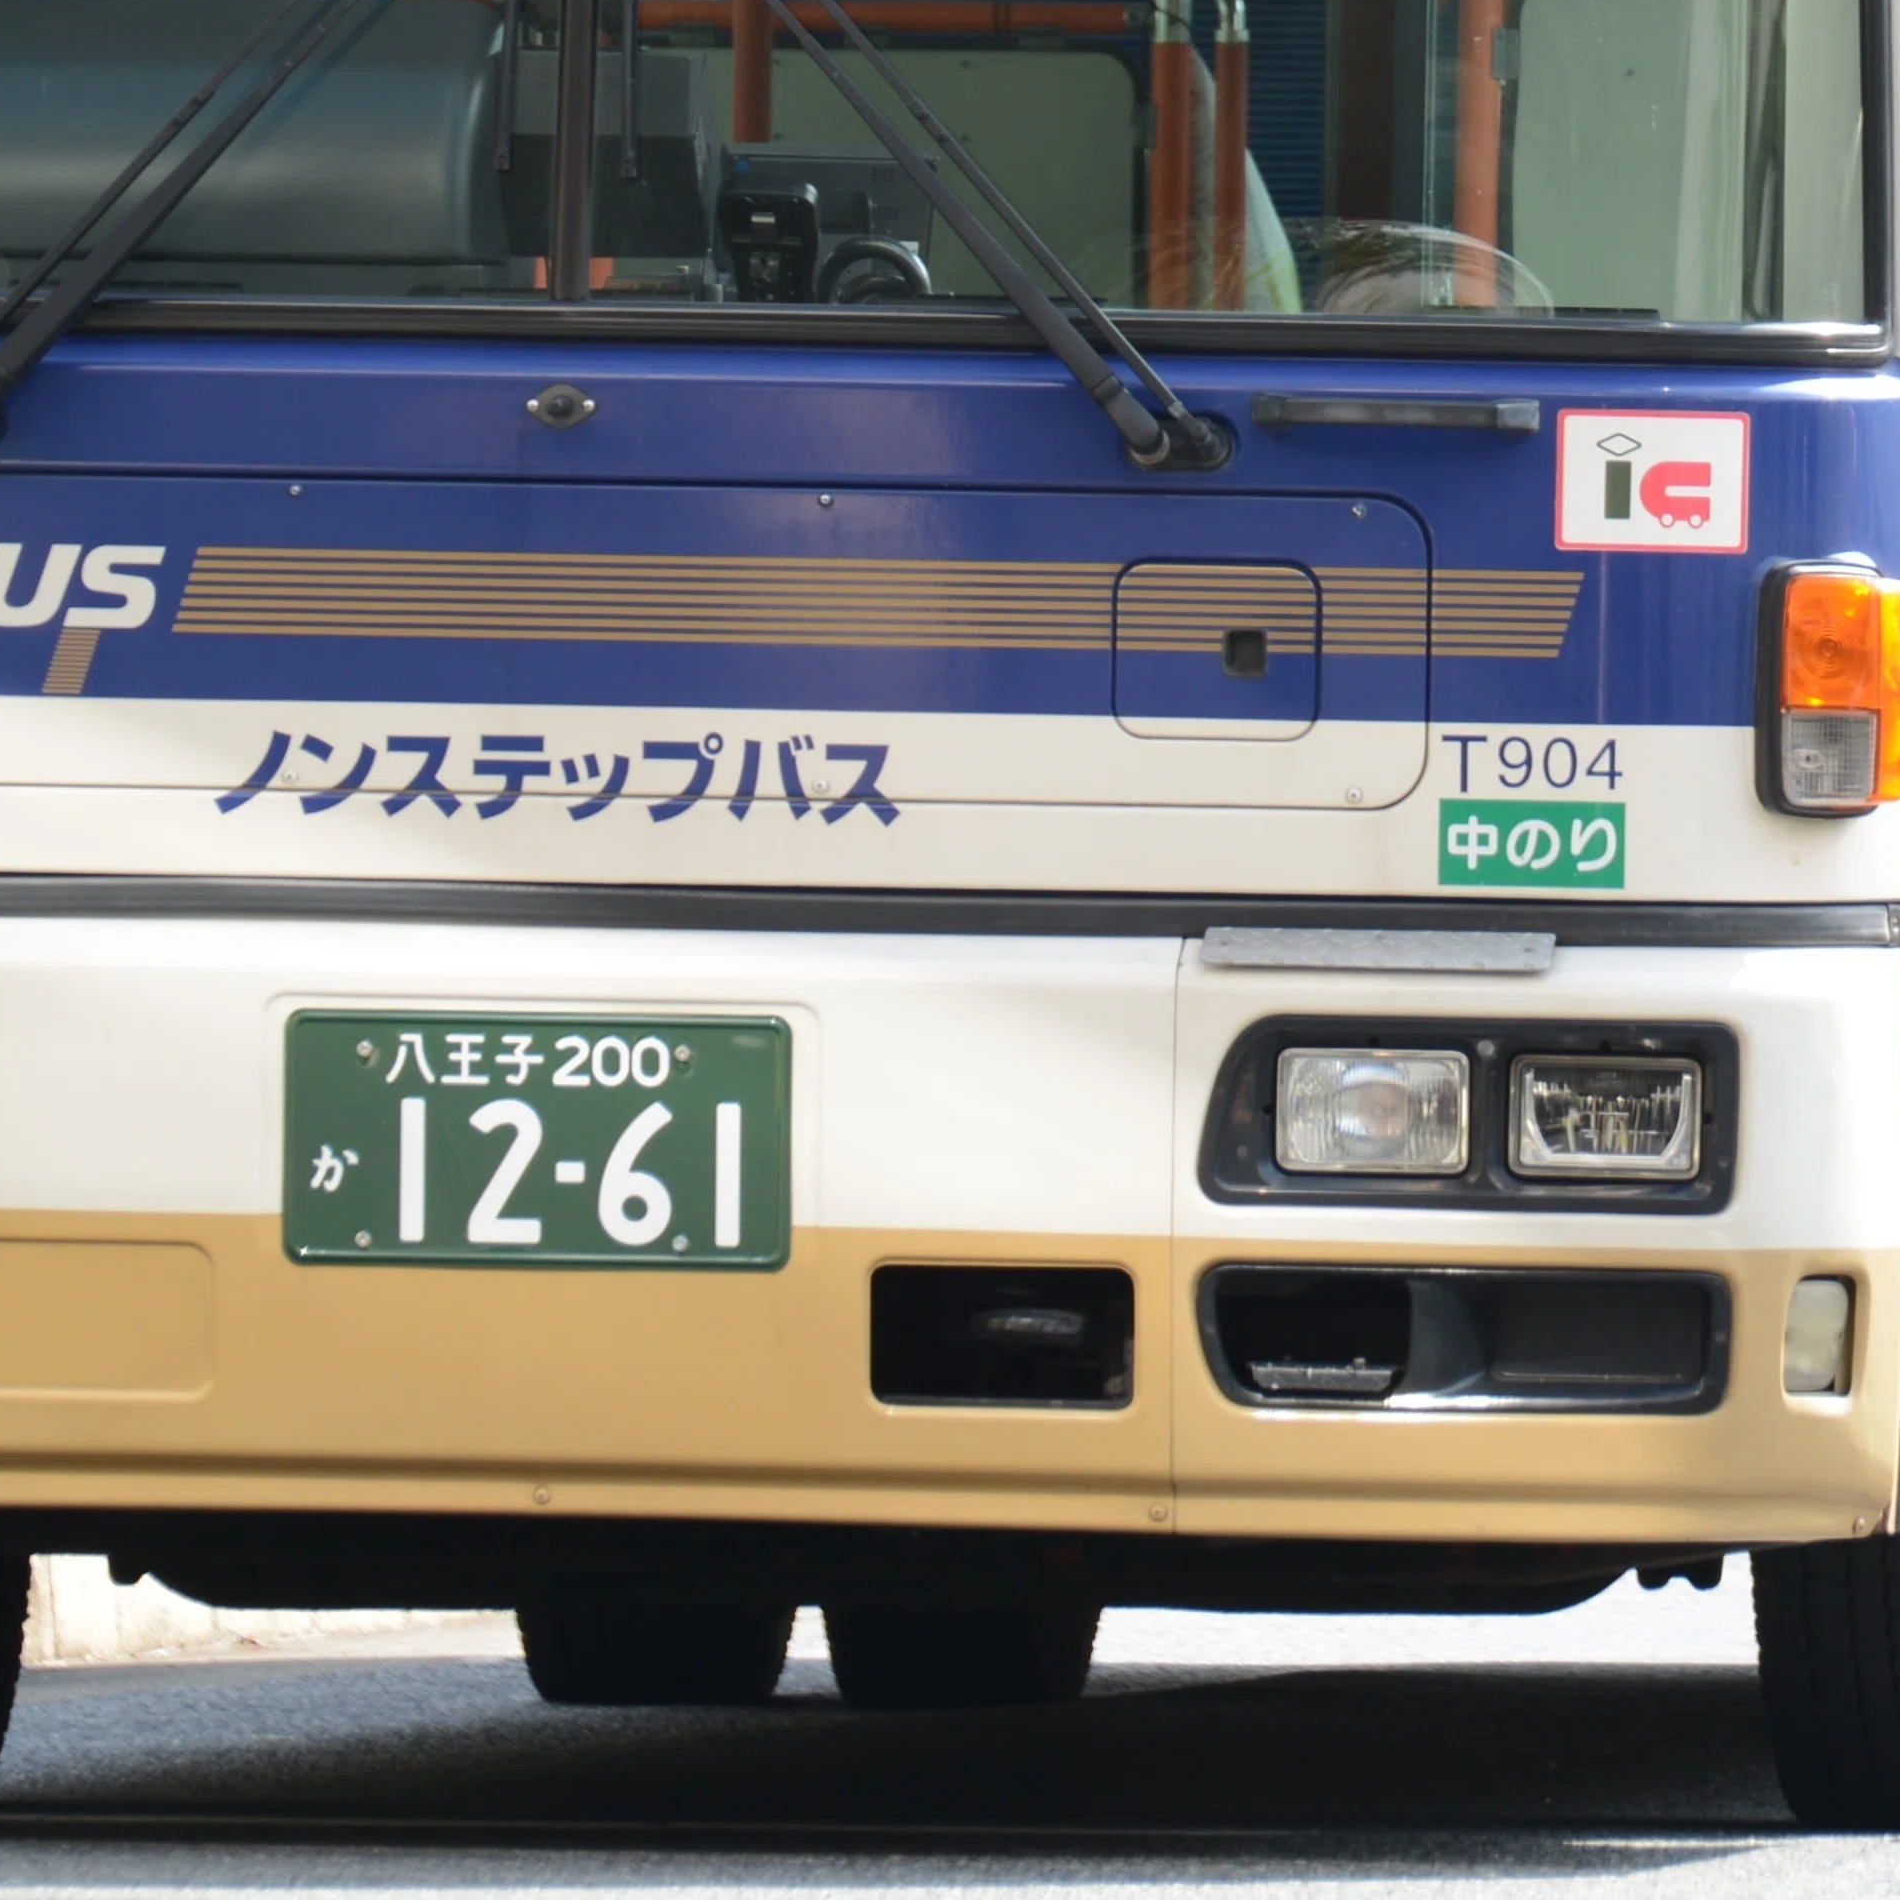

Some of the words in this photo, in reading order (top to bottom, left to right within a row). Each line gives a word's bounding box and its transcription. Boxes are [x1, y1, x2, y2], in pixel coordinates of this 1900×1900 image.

[213, 730, 901, 827] ノンステップバス
[1442, 734, 1624, 794] T904
[1446, 814, 1618, 873] 中のり
[309, 1144, 360, 1193] か
[398, 1096, 743, 1250] 12-61
